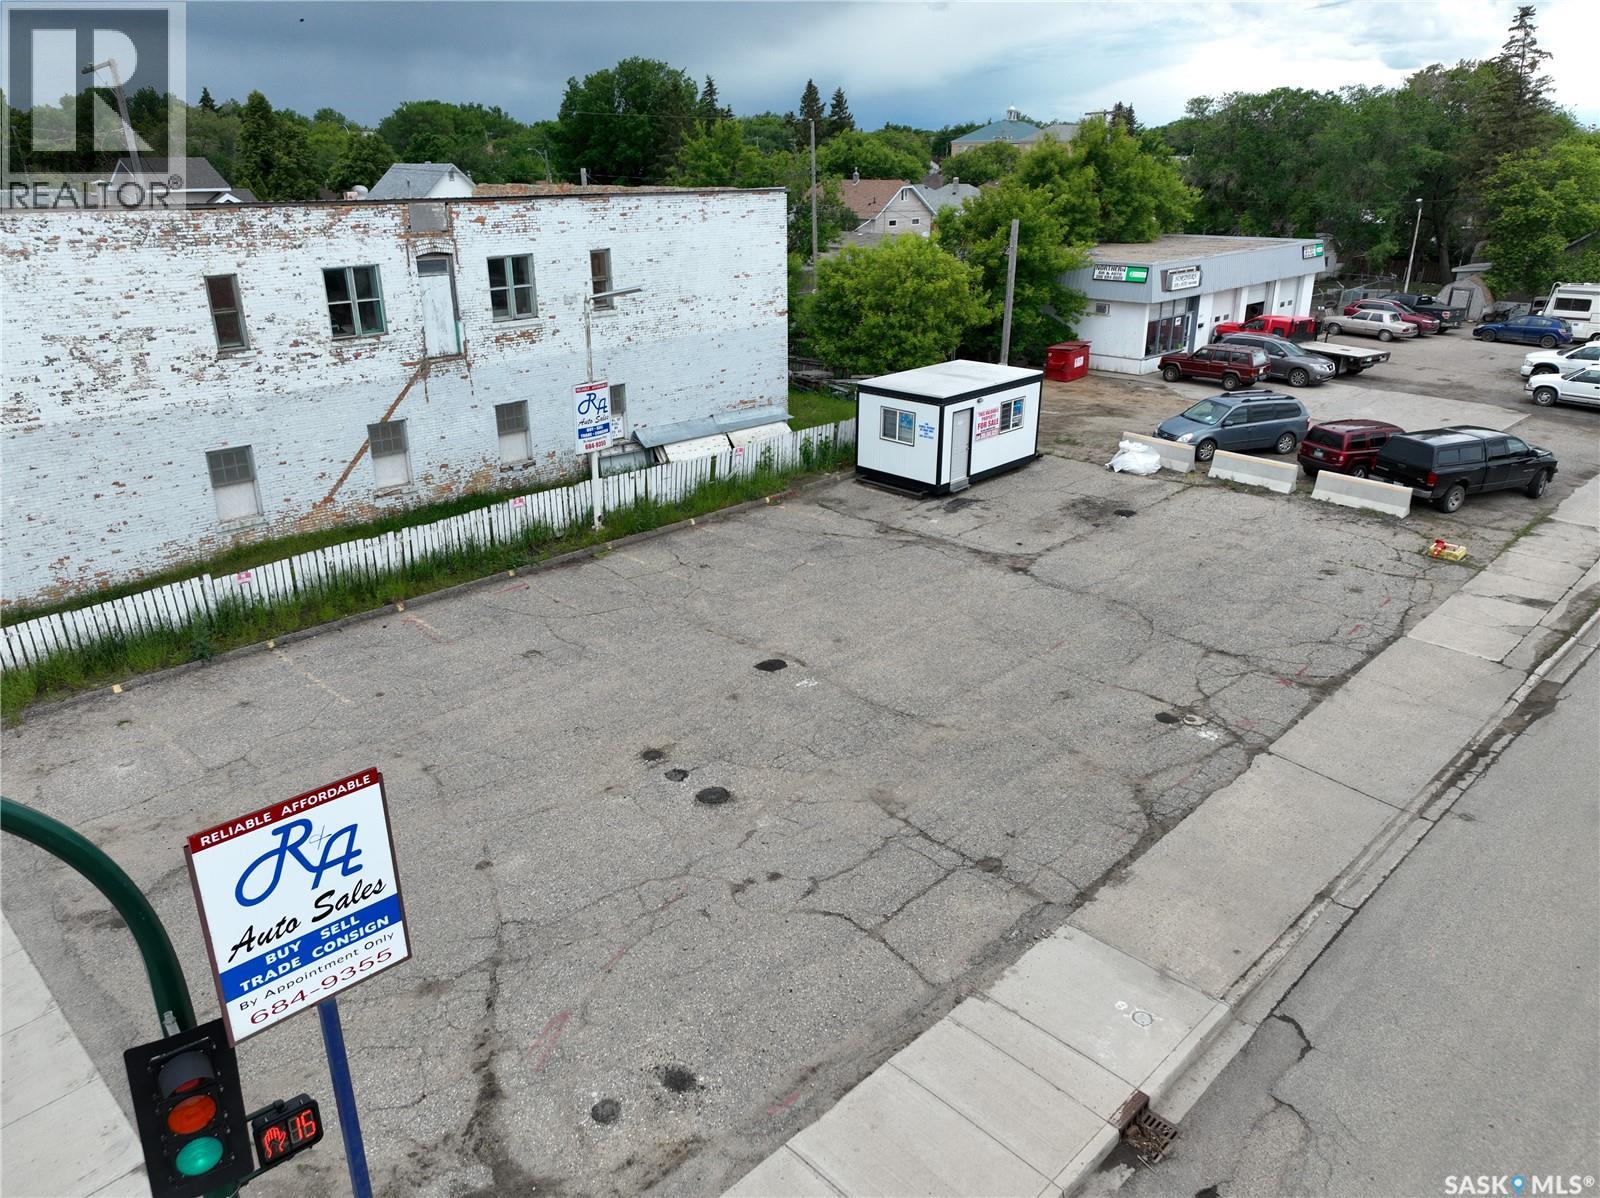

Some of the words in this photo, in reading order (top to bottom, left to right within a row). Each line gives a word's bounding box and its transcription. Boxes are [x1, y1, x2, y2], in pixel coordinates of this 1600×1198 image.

[578, 418, 593, 426] Auto
[978, 421, 987, 430] FOR
[200, 811, 272, 847] RELIABLE
[281, 774, 371, 817] AFFORDABLE
[227, 915, 301, 963] Auto
[311, 878, 387, 923] Sales
[239, 958, 302, 992] TRADE
[311, 915, 390, 959] CONSIGN
[265, 940, 302, 966] BUY
[320, 916, 360, 940] SELL
[240, 997, 258, 1011] By
[264, 948, 359, 1000] Appointment
[364, 931, 395, 951] Only
[250, 947, 393, 1025] 684-9355
[296, 1109, 316, 1140] 15
